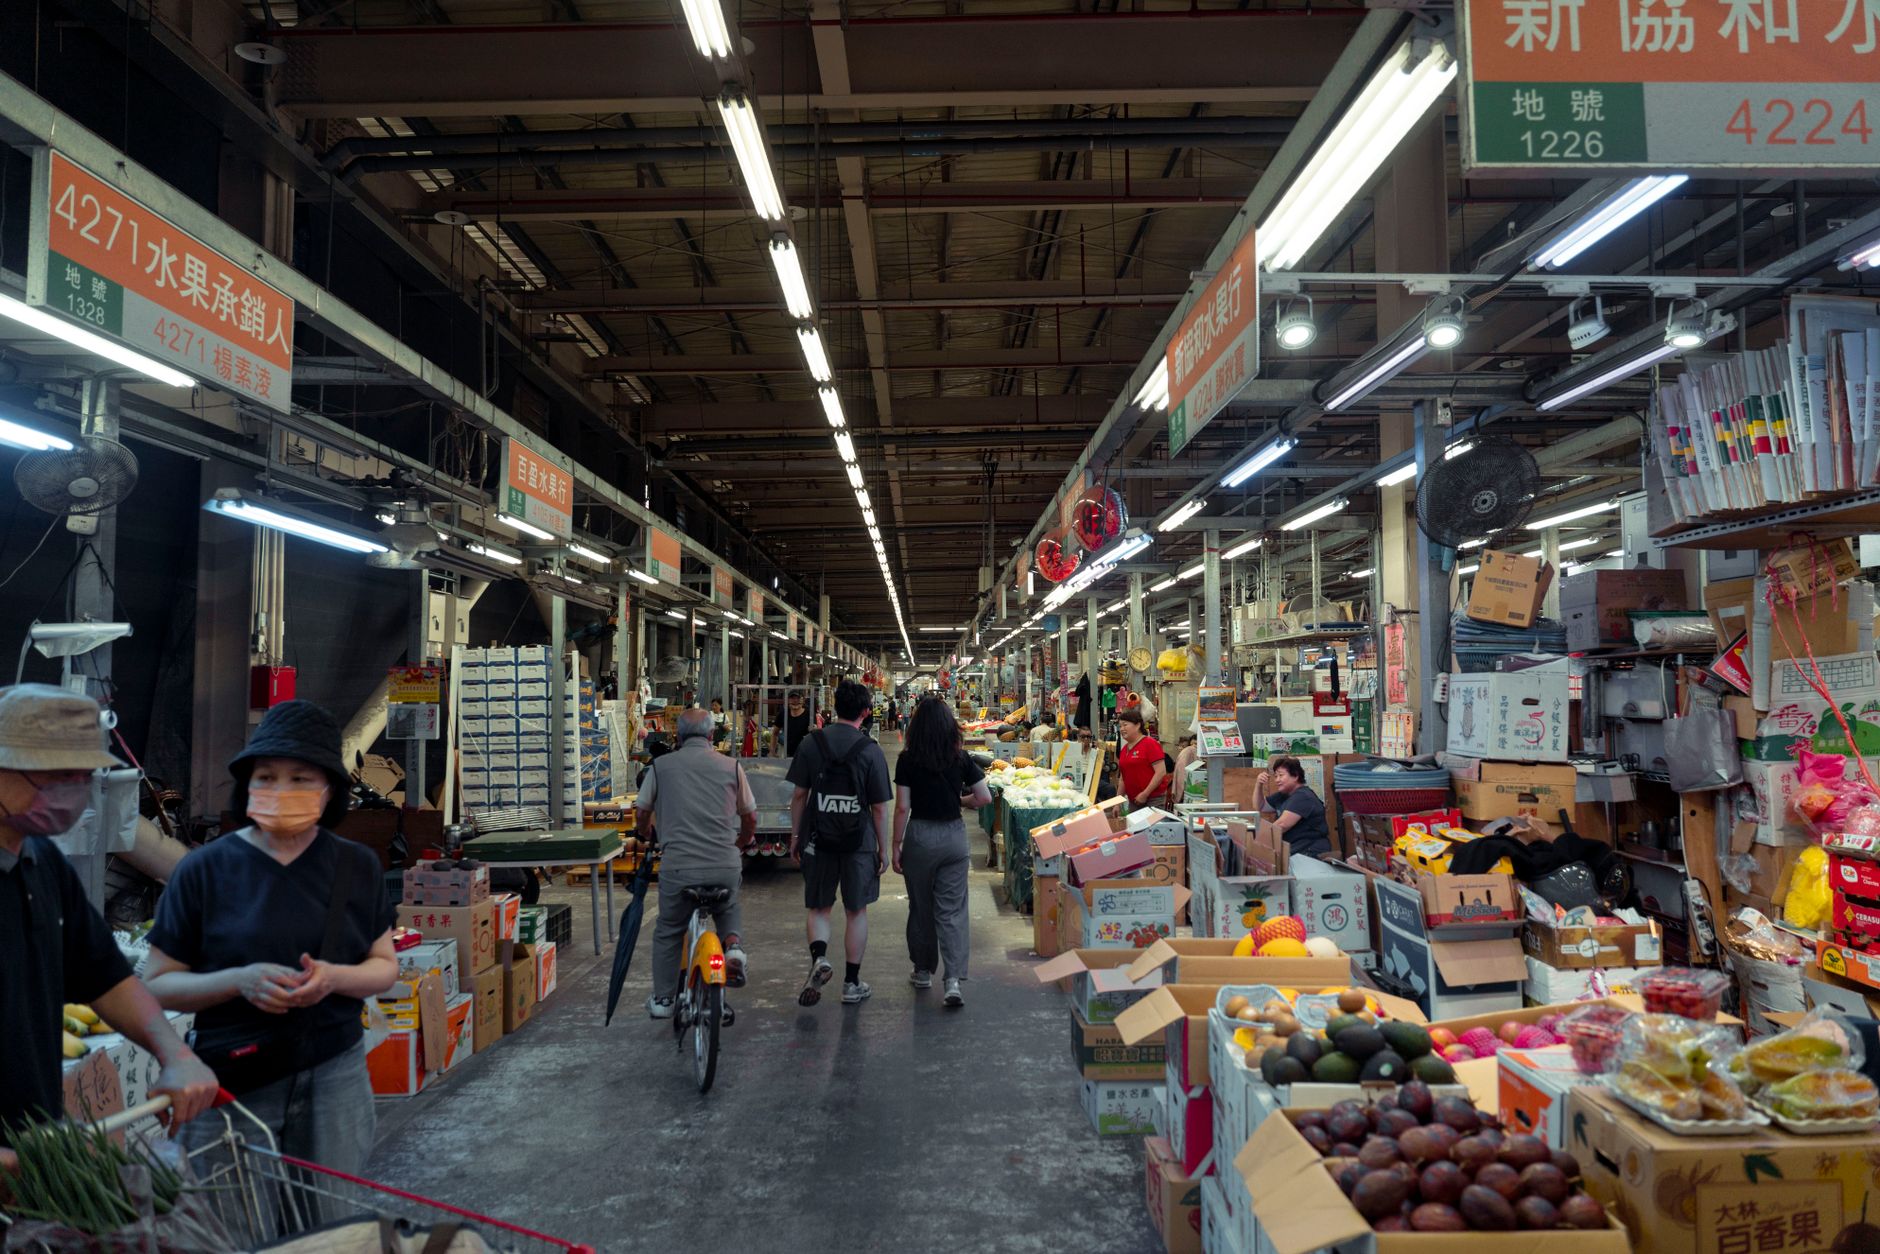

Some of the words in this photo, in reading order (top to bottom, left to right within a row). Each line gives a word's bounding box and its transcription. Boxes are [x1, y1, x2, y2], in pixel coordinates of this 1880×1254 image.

[1512, 89, 1605, 122] 地號
[1725, 98, 1873, 145] 4224
[1520, 131, 1604, 158] 1226
[65, 264, 107, 303] 地號
[67, 294, 105, 325] 1328
[518, 454, 566, 505] 百盈水果行
[818, 792, 861, 813] VANS
[412, 913, 452, 928] 百香果
[1714, 1201, 1759, 1224] 大林
[1716, 1210, 1822, 1254] 百香果
